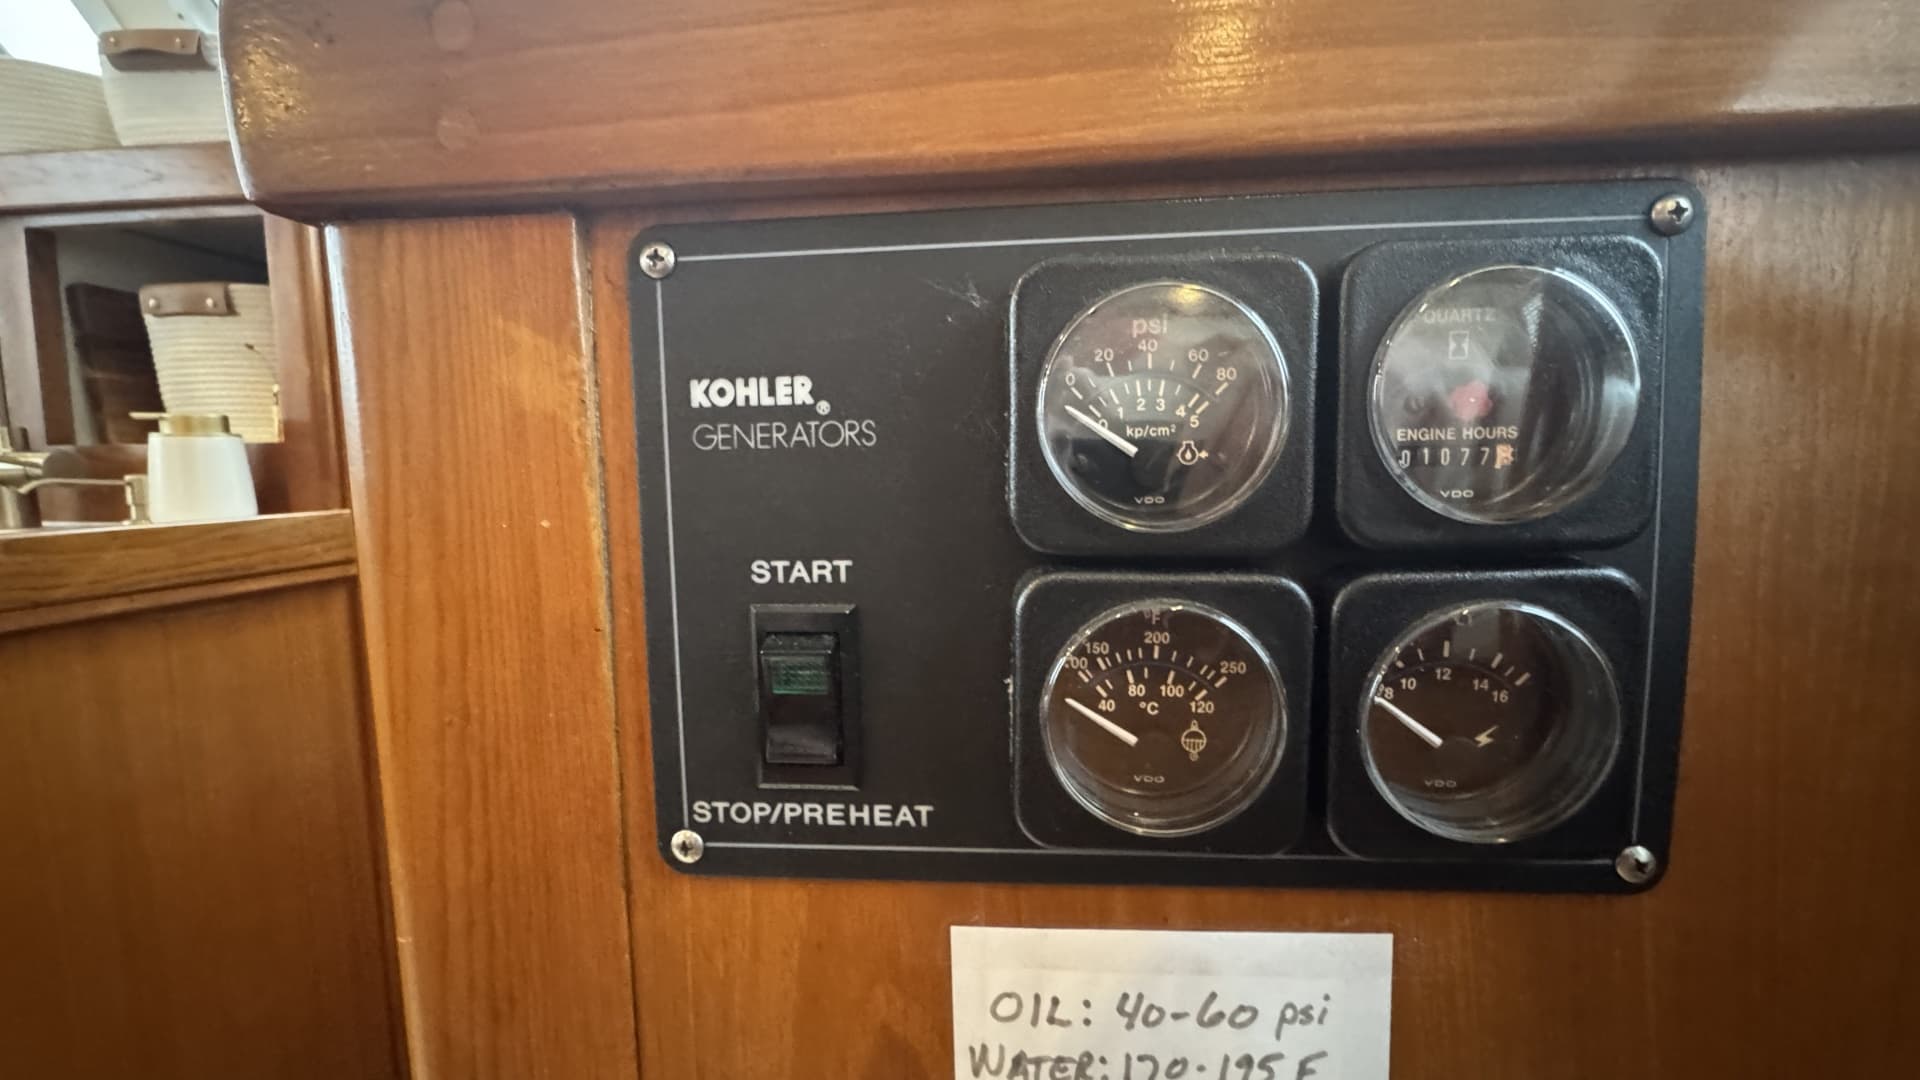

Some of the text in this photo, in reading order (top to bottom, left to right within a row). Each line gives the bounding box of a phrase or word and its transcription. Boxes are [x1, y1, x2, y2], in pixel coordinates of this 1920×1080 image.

[1424, 307, 1496, 324] QUARTZ
[1132, 313, 1168, 338] psi
[1137, 340, 1158, 352] 40
[1094, 348, 1115, 362] 20
[1188, 349, 1209, 362] 60
[1065, 373, 1076, 386] 0
[1216, 367, 1237, 381] 80
[1136, 398, 1146, 412] 2
[1155, 398, 1166, 412] 3
[1176, 405, 1187, 418] 4
[1117, 407, 1124, 419] 1
[1190, 416, 1200, 428] 5
[692, 420, 877, 450] GENERATORS
[1396, 426, 1519, 441] ENGINE HOURS
[1134, 496, 1165, 504] VDO
[1440, 490, 1474, 498] VDO
[750, 560, 853, 584] START
[1144, 632, 1170, 644] 200
[1085, 641, 1109, 655] 150
[1220, 661, 1247, 675] 250
[1435, 668, 1451, 681] 12
[1400, 678, 1417, 690] 10
[1473, 679, 1489, 691] 14
[1128, 685, 1146, 697] 80
[1160, 685, 1184, 697] 100
[1492, 690, 1509, 703] 16
[1098, 700, 1116, 712] 40
[1190, 701, 1215, 714] 120
[1134, 775, 1165, 784] VDO
[1424, 779, 1457, 788] VDO
[692, 801, 934, 829] STOP/PREHEAT
[990, 991, 1331, 1041] OIL: 40-60 psi
[969, 1043, 1109, 1080] WATER:
